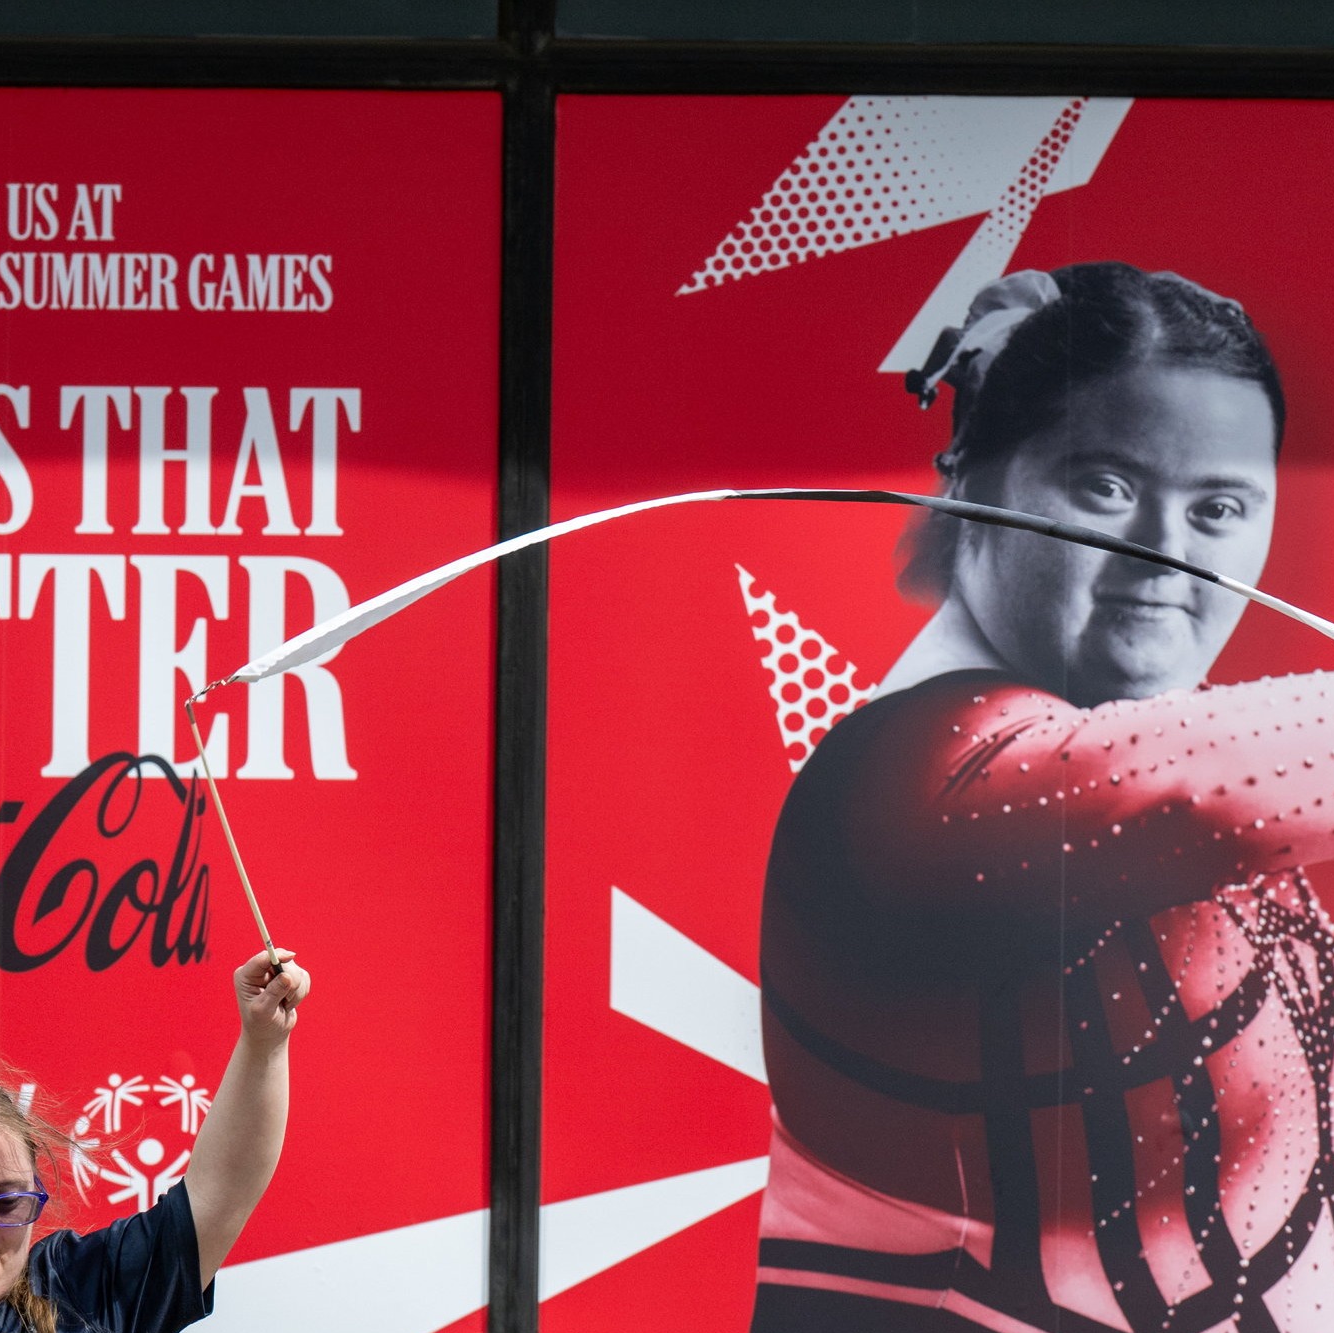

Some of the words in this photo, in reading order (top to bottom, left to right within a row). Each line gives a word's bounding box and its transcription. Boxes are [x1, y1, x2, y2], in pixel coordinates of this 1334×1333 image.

[6, 183, 58, 240] US
[66, 184, 121, 241] AT
[188, 254, 333, 312] GAMES
[59, 386, 362, 536] THAT
